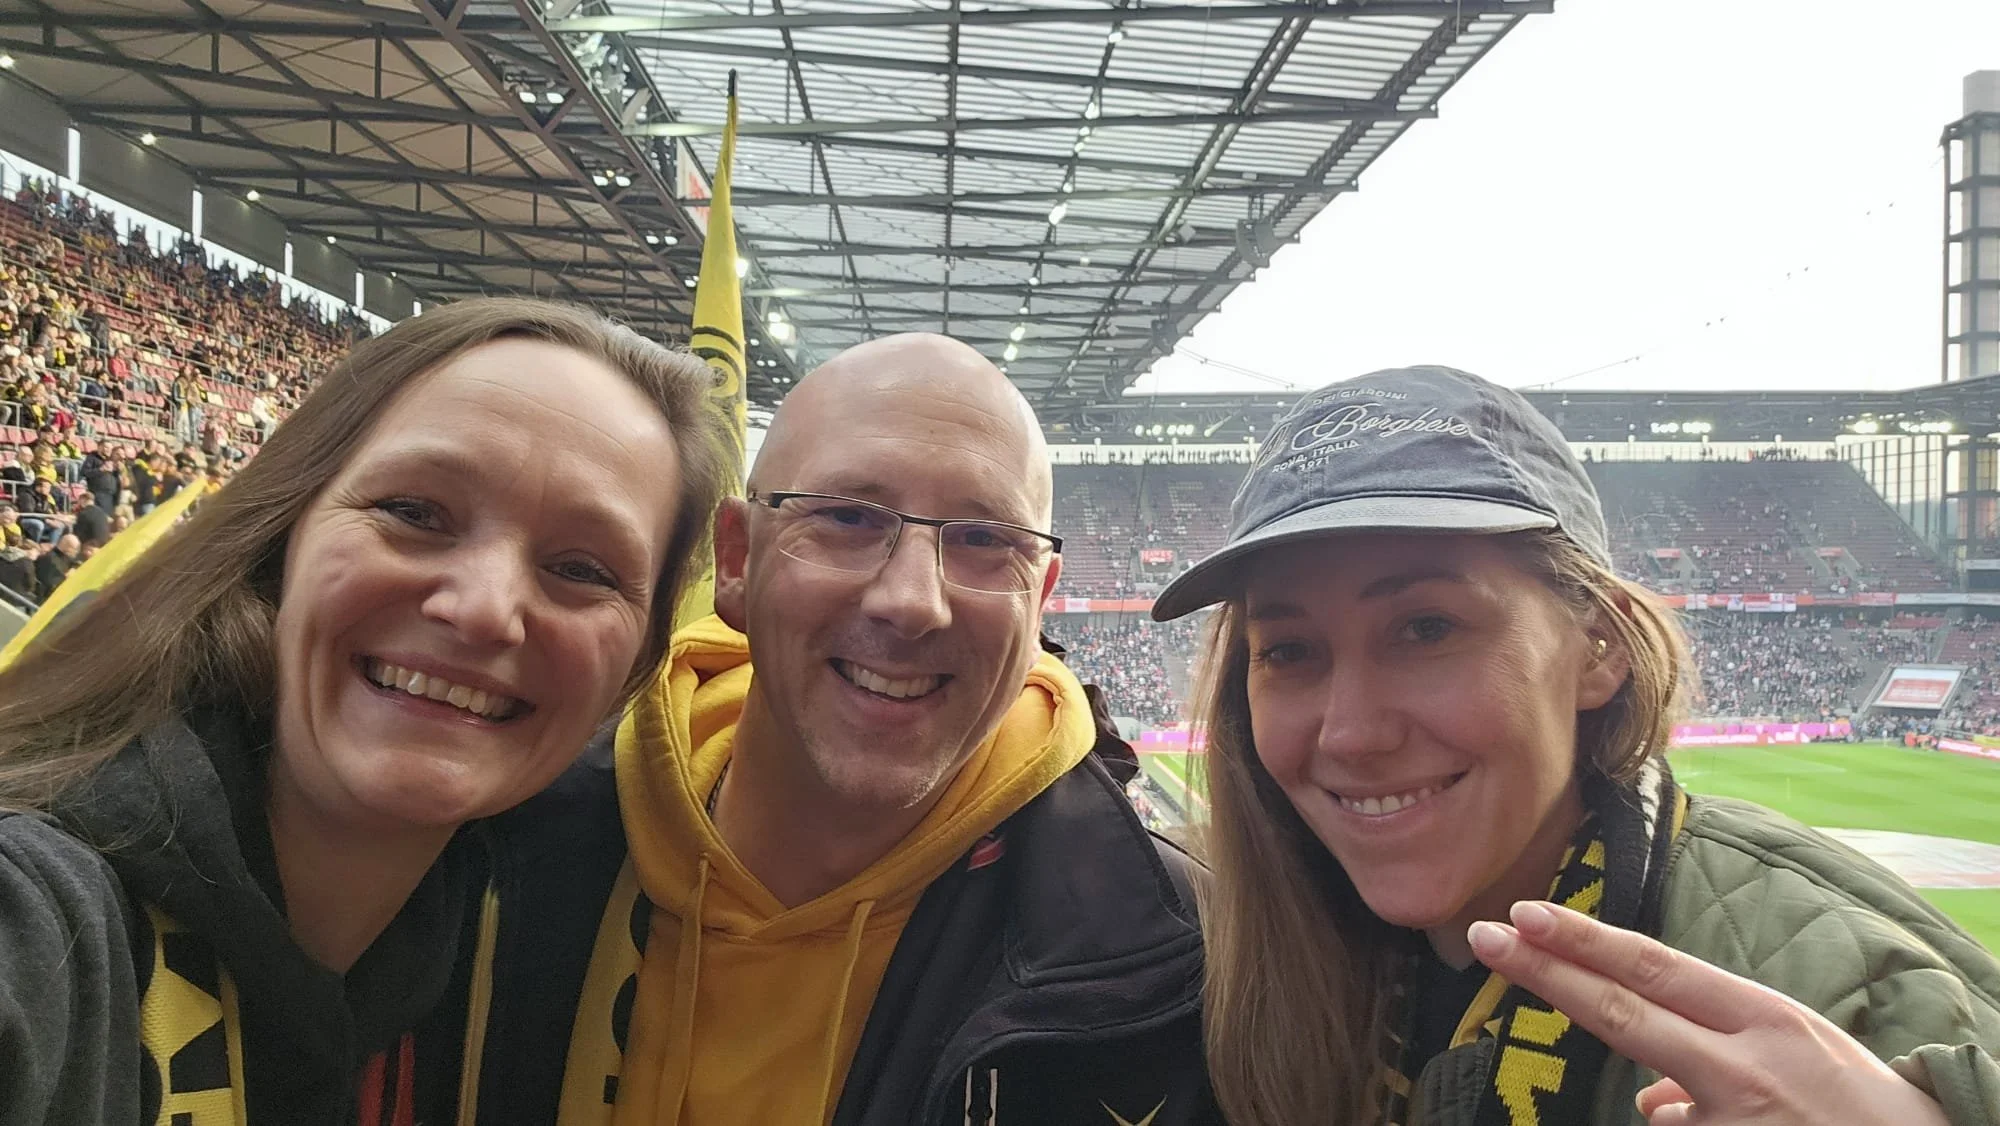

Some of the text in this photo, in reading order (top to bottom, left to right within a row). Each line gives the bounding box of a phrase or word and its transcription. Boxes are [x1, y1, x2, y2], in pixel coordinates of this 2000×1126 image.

[1340, 388, 1408, 400] GIARDINI
[1292, 404, 1469, 450] Borghese
[1313, 439, 1360, 458] ITALIA
[1299, 456, 1329, 472] 1971
